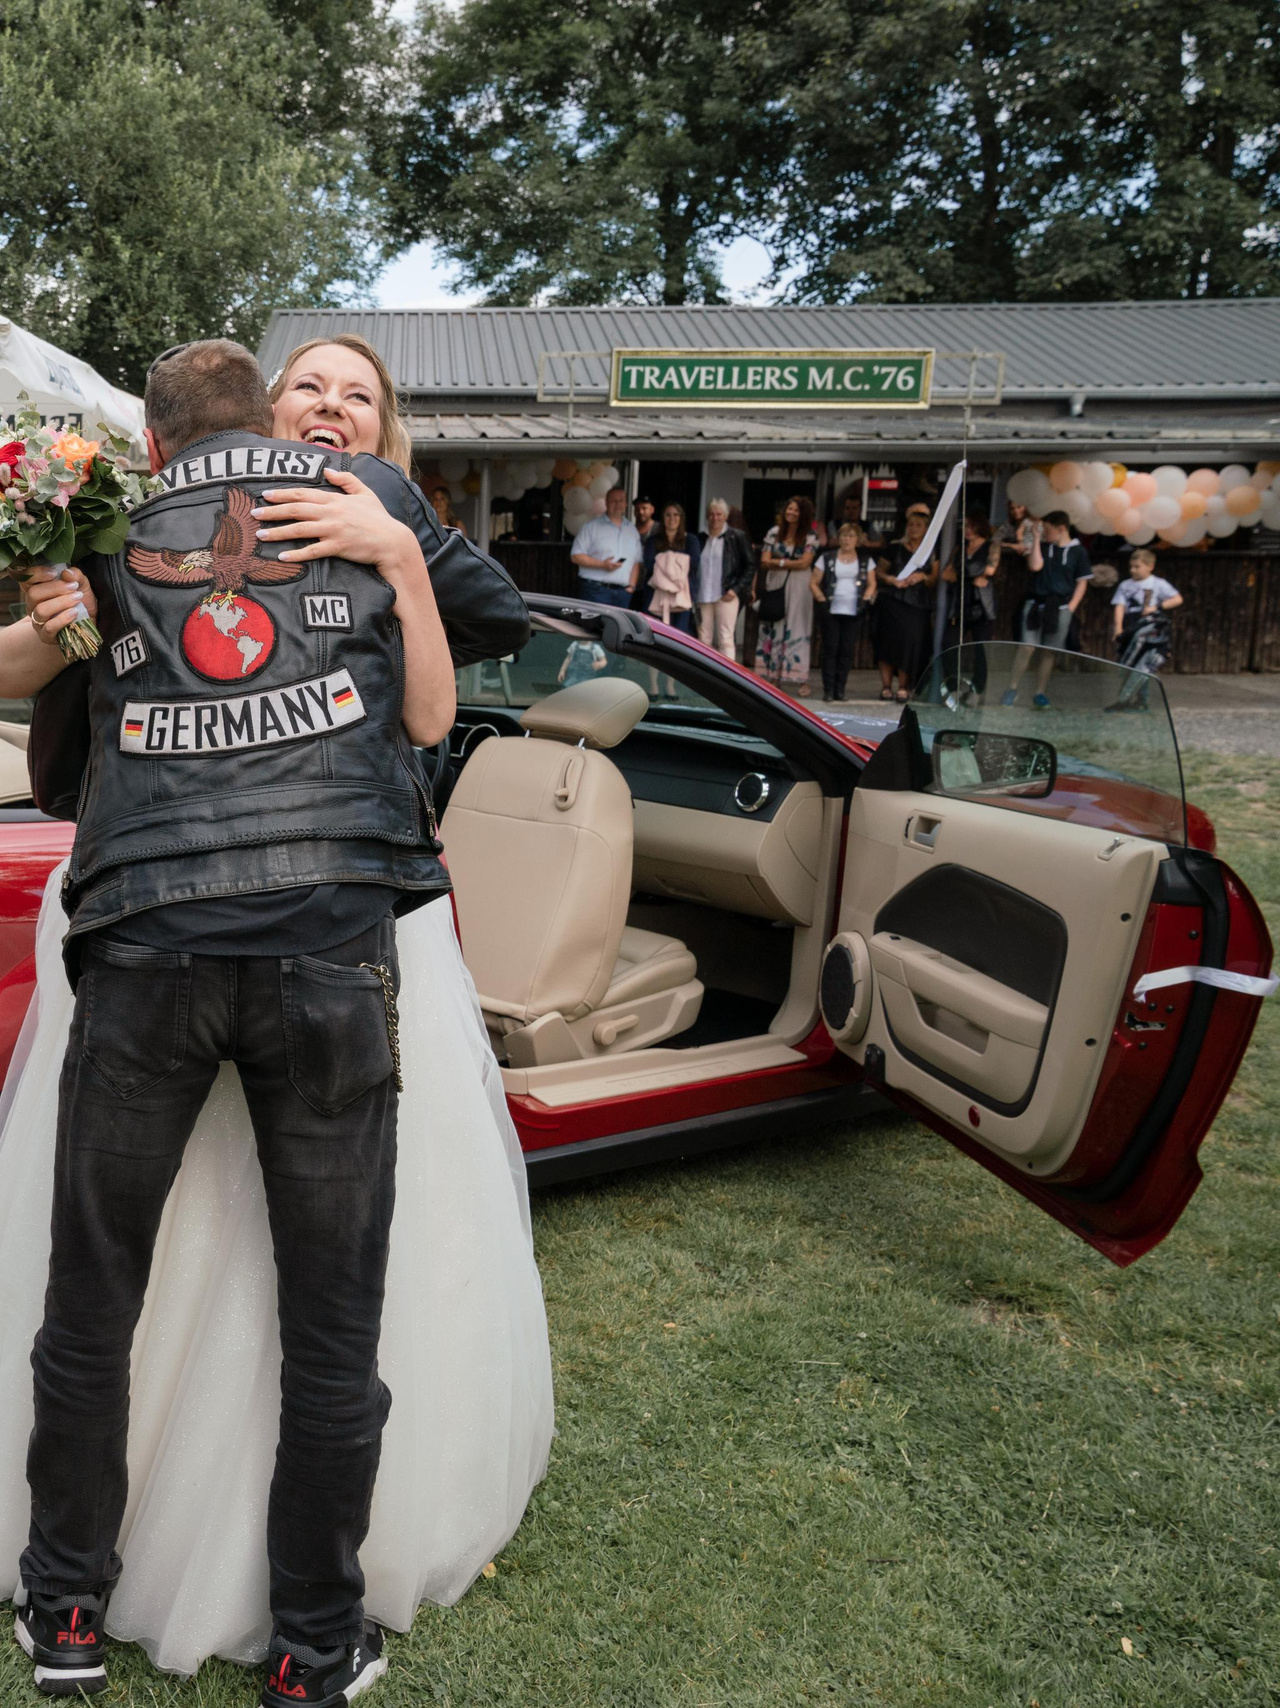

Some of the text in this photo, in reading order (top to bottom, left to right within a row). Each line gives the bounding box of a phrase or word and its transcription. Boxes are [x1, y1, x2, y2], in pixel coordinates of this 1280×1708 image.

[624, 365, 799, 391] TRAVELLERS
[311, 597, 346, 625] MC
[113, 637, 142, 671] 76
[145, 680, 334, 752] GERMANY
[57, 1631, 97, 1645] FILA
[269, 1674, 307, 1698] FILA
